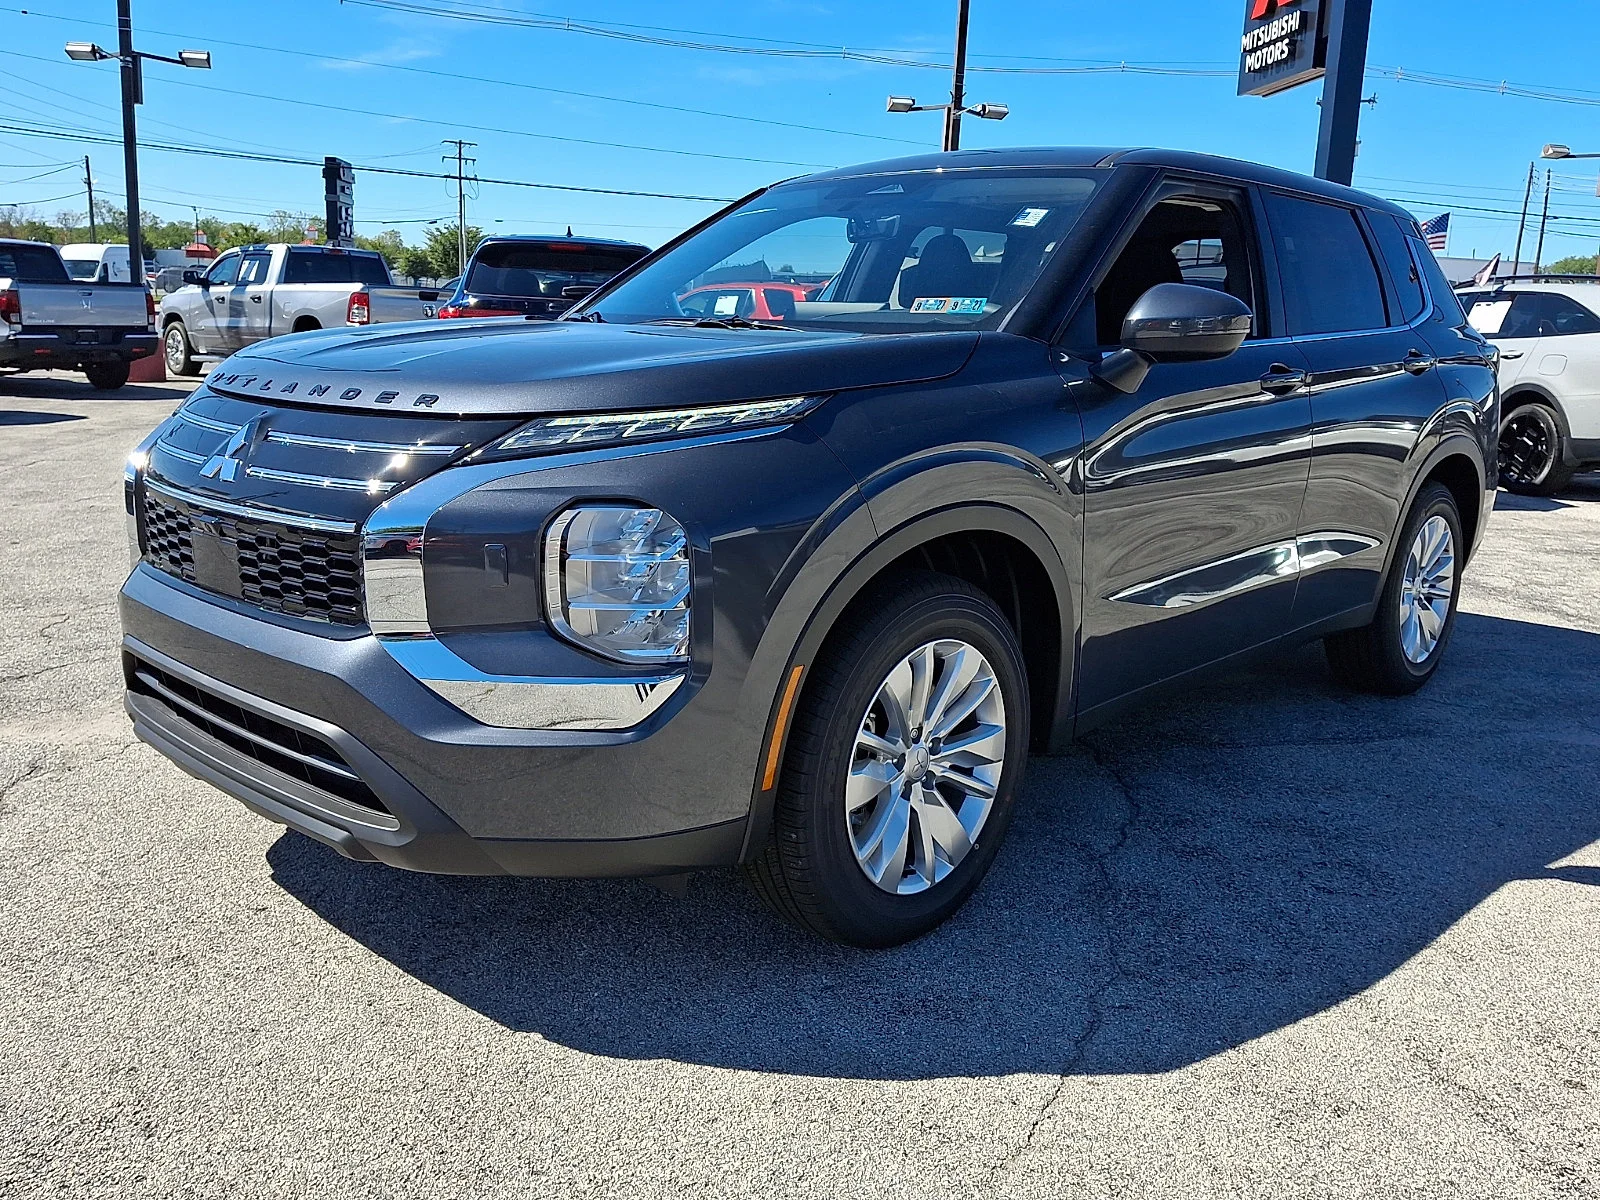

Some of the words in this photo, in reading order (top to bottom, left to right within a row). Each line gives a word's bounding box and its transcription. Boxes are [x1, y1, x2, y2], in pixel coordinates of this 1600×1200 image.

[1241, 10, 1300, 53] MITSUBISHI
[1245, 38, 1289, 73] MOTORS
[915, 302, 922, 311] 9
[936, 300, 946, 311] 27
[951, 301, 958, 311] 9
[972, 300, 982, 311] 27
[211, 372, 439, 408] OUTLANDER
